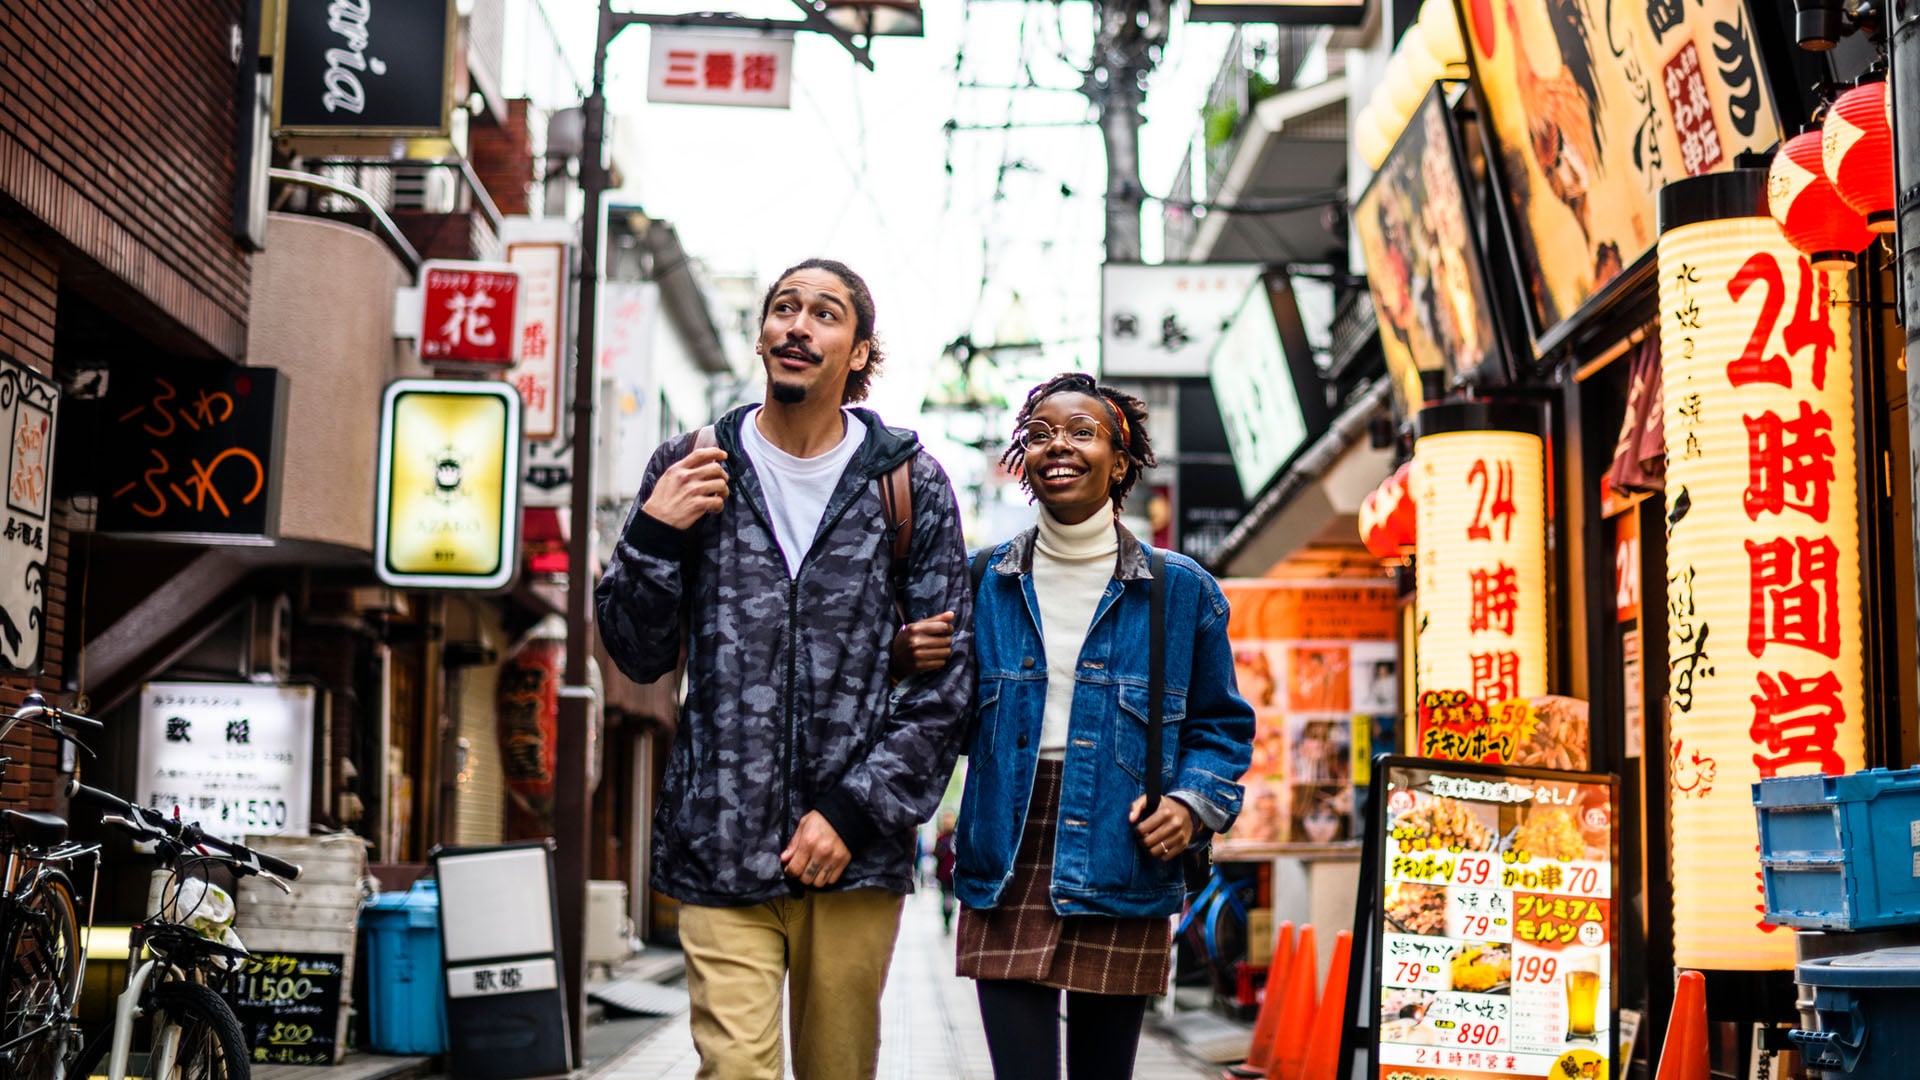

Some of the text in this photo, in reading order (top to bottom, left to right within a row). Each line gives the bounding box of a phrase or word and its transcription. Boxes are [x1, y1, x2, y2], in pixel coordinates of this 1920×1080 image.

[663, 52, 776, 91] 三番街
[440, 290, 497, 346] 花
[3, 516, 44, 551] 居酒屋
[1466, 458, 1520, 708] 24時間
[1500, 705, 1527, 724] 59
[1457, 857, 1490, 885] 59
[1567, 866, 1598, 894] 70
[1517, 895, 1604, 921] プレミアム
[1462, 915, 1489, 937] 79
[1516, 919, 1578, 943] モルツ
[1390, 938, 1454, 960] 串カツ
[474, 967, 523, 990] 歌姫
[1395, 961, 1422, 983] 79
[1516, 955, 1557, 984] 199
[1454, 997, 1508, 1021] 水炊き
[1457, 1022, 1499, 1046] 890
[1415, 1048, 1518, 1071] 24時間営業
